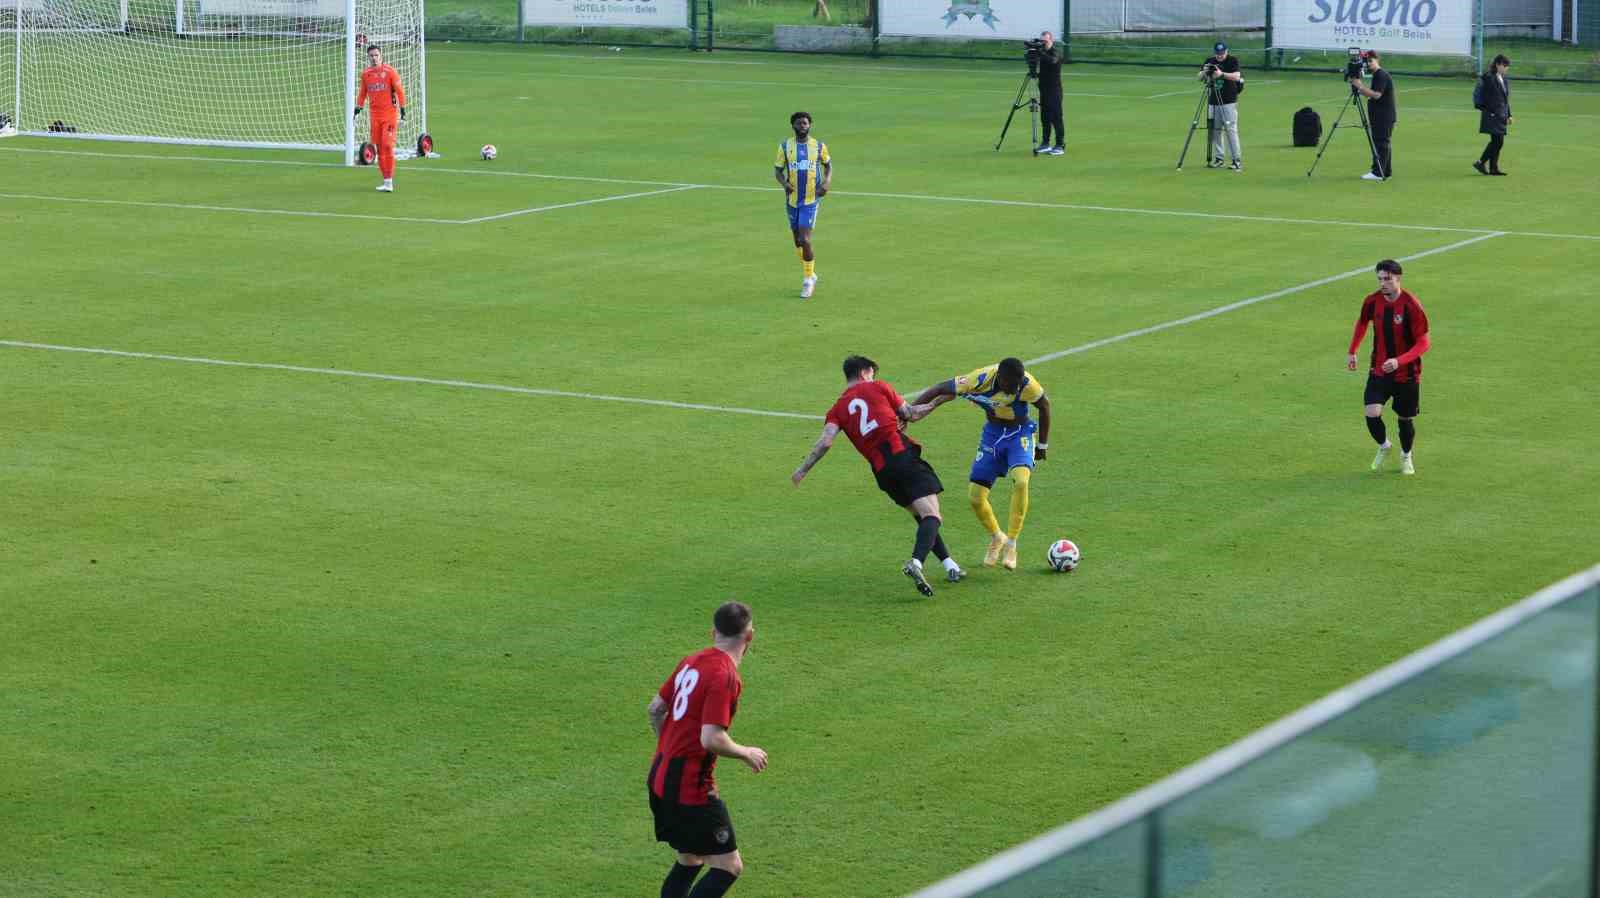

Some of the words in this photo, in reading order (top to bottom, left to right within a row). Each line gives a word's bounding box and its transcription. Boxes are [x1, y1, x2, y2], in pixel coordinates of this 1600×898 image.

[574, 4, 606, 13] HOTELS
[1334, 26, 1376, 36] HOTELS
[1378, 27, 1401, 38] Golf
[1402, 29, 1432, 40] Belek
[848, 398, 879, 437] 2
[668, 664, 700, 721] 18
